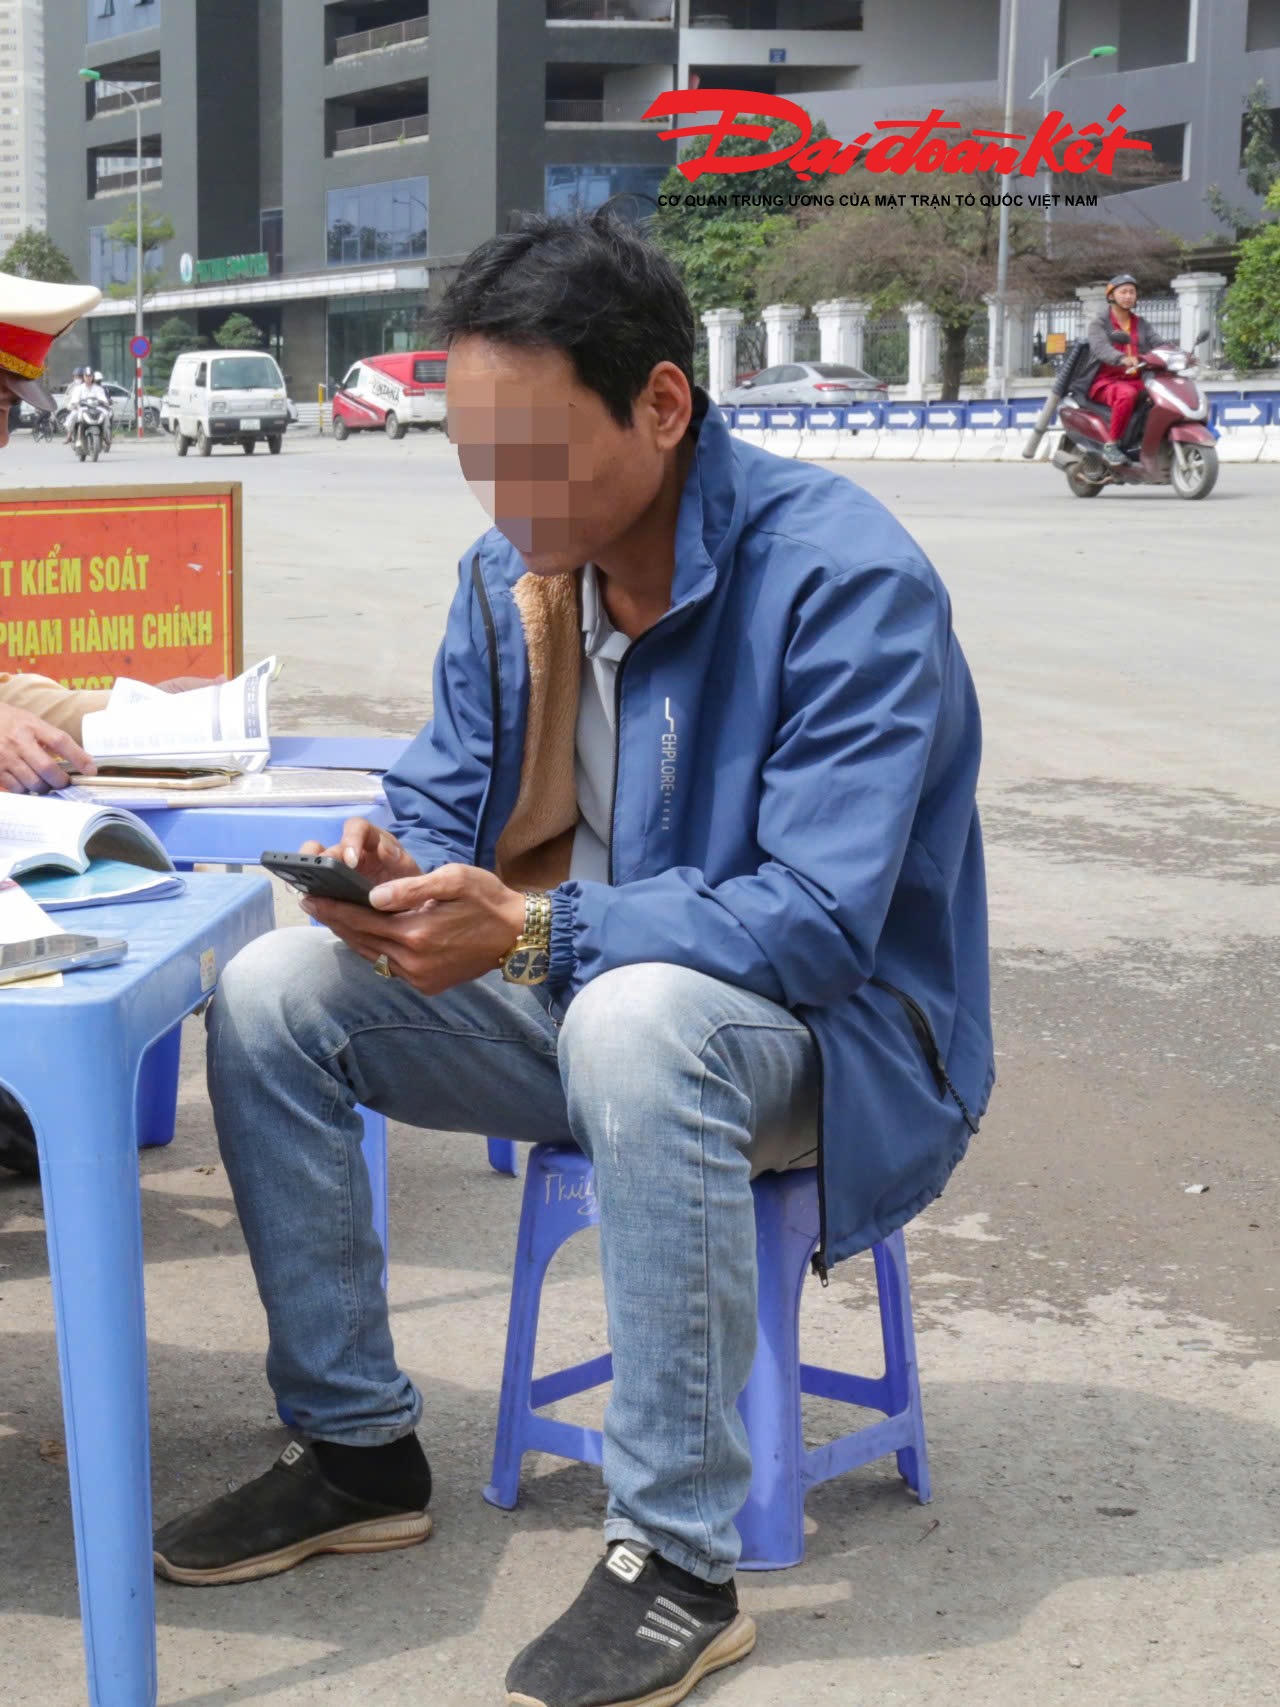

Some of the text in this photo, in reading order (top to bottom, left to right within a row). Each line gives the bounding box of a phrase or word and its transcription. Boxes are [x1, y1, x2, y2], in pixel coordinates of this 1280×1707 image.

[21, 543, 82, 596] KIỂM
[89, 548, 149, 592] SOÁT
[70, 609, 134, 653] HÀNH
[142, 604, 213, 648] CHÍNH
